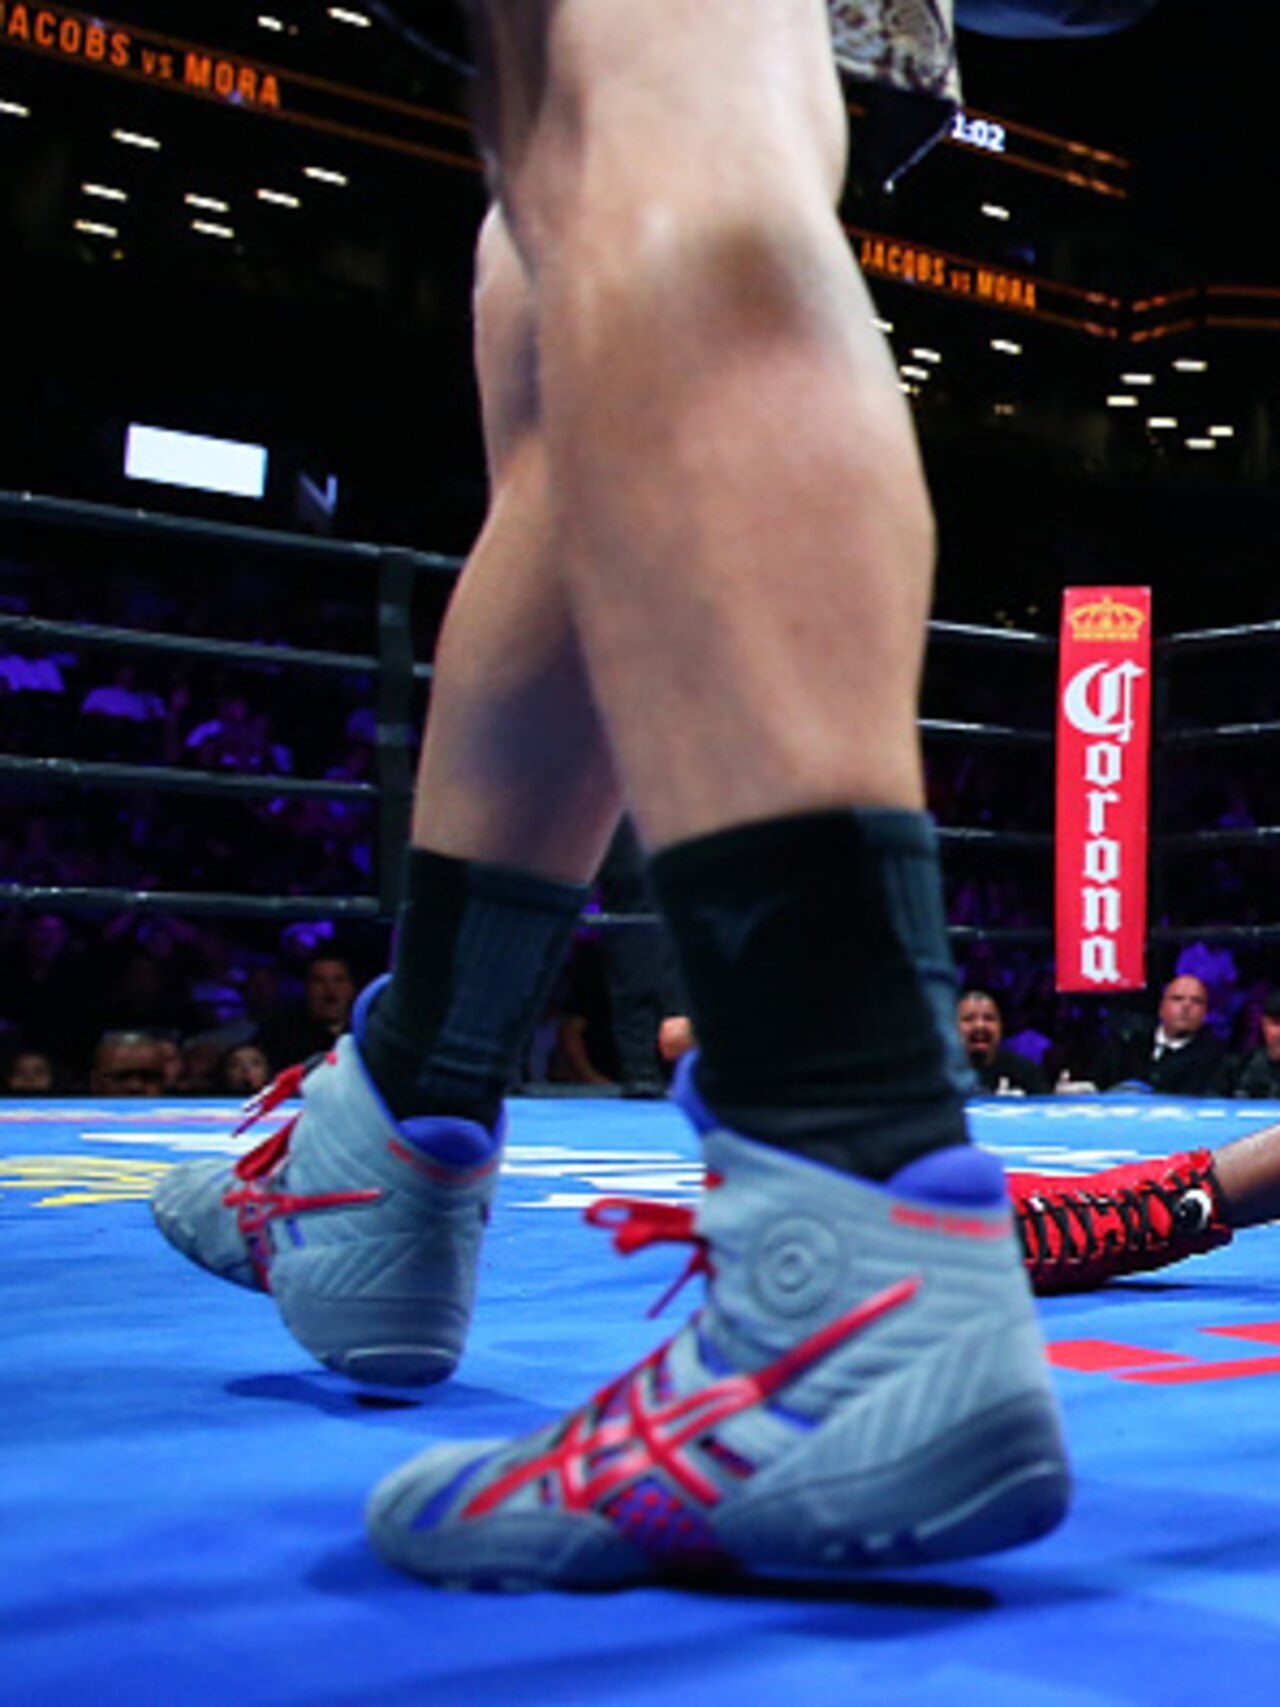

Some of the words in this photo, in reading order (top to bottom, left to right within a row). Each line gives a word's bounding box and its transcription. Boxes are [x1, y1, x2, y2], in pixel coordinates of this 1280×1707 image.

[184, 52, 282, 108] MORA
[861, 239, 945, 287] JACOBS
[976, 268, 1036, 311] MORA
[1063, 658, 1146, 984] Corona
